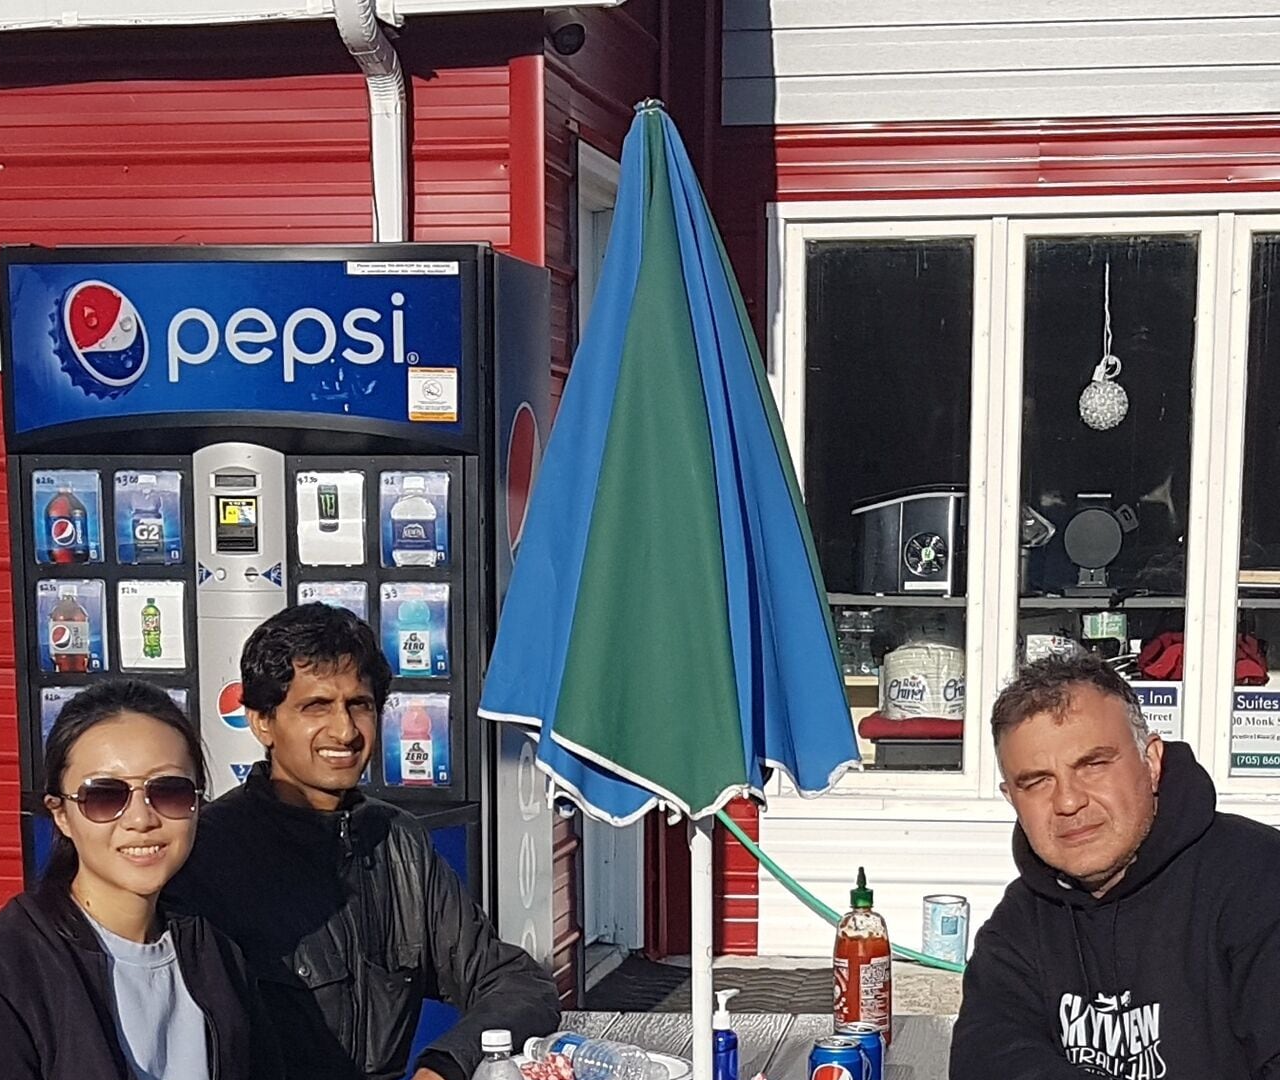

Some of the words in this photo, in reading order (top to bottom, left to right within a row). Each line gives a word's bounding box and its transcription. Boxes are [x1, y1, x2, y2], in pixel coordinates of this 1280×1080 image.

[167, 291, 406, 382] pepsi
[134, 524, 160, 541] G2
[402, 641, 425, 651] ZERO
[1149, 690, 1173, 705] Inn
[1236, 694, 1280, 710] Suites
[1232, 716, 1243, 726] 00
[1245, 716, 1275, 726] Monk
[405, 752, 429, 761] ZERO
[1236, 755, 1260, 767] (705)
[1059, 993, 1160, 1057] SKYVIEW
